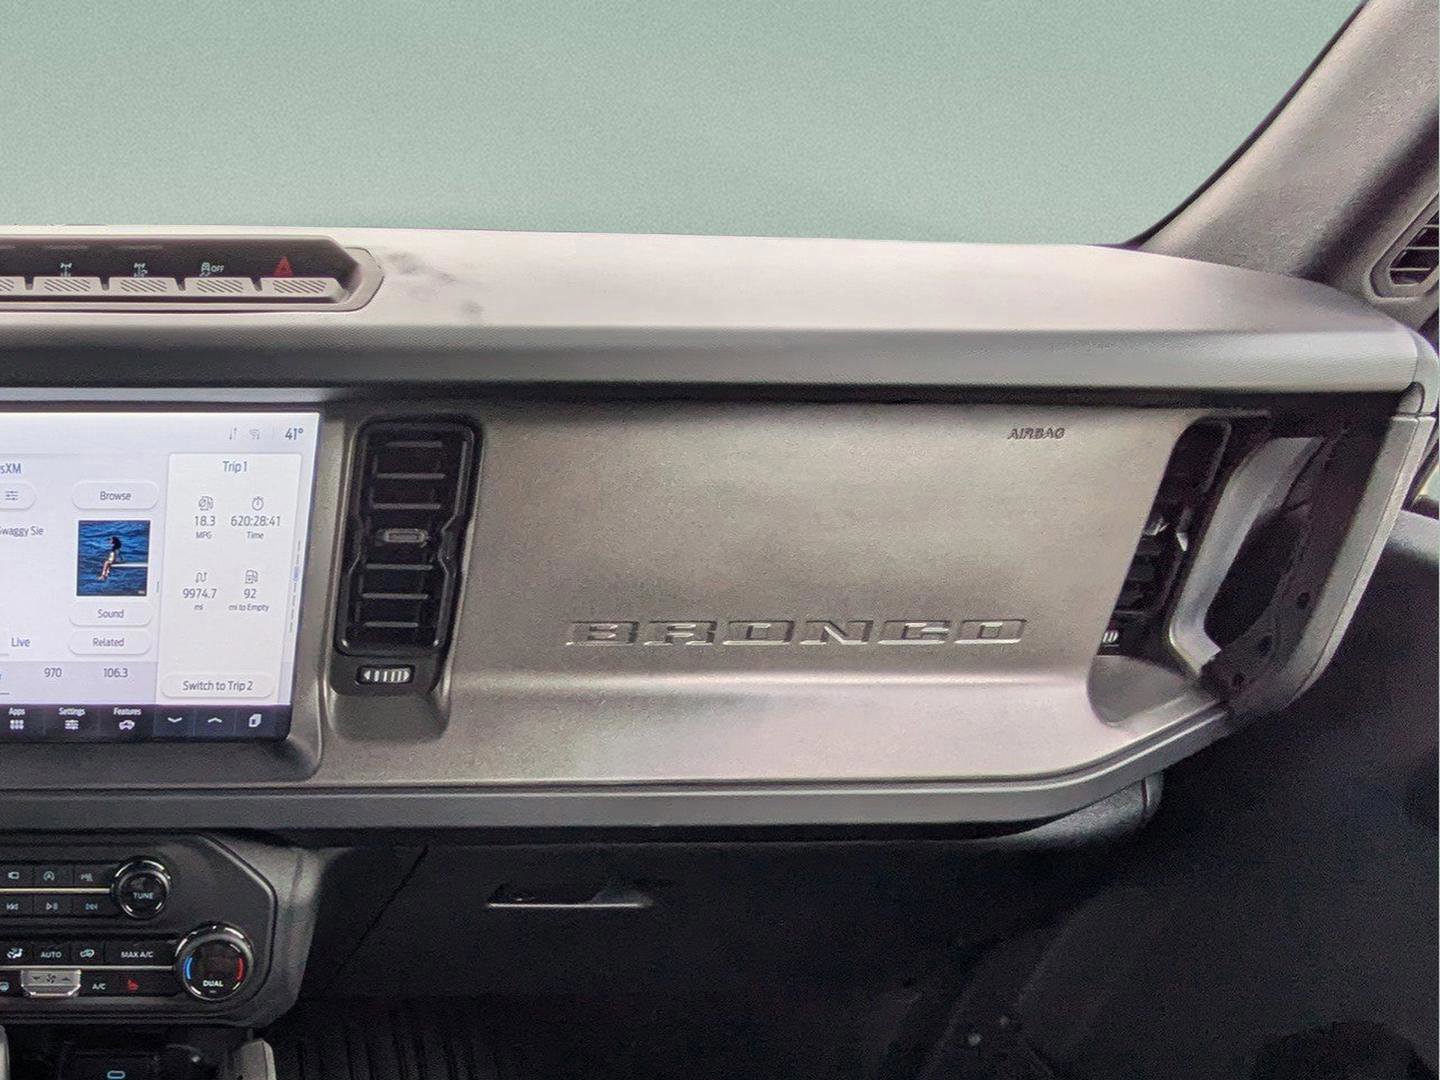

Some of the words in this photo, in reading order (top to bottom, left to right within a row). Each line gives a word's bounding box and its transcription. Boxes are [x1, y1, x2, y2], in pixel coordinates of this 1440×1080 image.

[285, 427, 304, 440] 41°
[1007, 427, 1066, 440] AIRBAG
[223, 461, 242, 473] Trip
[243, 461, 248, 472] 1
[100, 491, 131, 501] Browse
[194, 515, 216, 526] 18.3
[230, 515, 281, 526] 620:28:41
[30, 525, 44, 536] Sie
[196, 532, 212, 540] MPG
[247, 532, 264, 540] Time
[182, 588, 217, 599] 9974.7
[244, 588, 257, 599] 92
[194, 603, 204, 611] mi
[228, 603, 238, 611] mi
[247, 603, 269, 612] Empty
[97, 609, 124, 618] Sound
[564, 618, 1029, 647] BRONCO
[11, 637, 30, 648] Live
[93, 637, 125, 647] Related
[44, 667, 63, 678] 970
[103, 667, 128, 678] 106.3
[183, 680, 213, 690] Switch
[215, 681, 226, 690] to
[227, 680, 247, 692] Trip
[247, 680, 253, 690] 2
[9, 707, 25, 716] Apps
[59, 707, 86, 716] Settings
[113, 707, 141, 716] Features
[40, 951, 62, 959] AUTO
[121, 951, 139, 959] MAX
[140, 951, 154, 959] A/C
